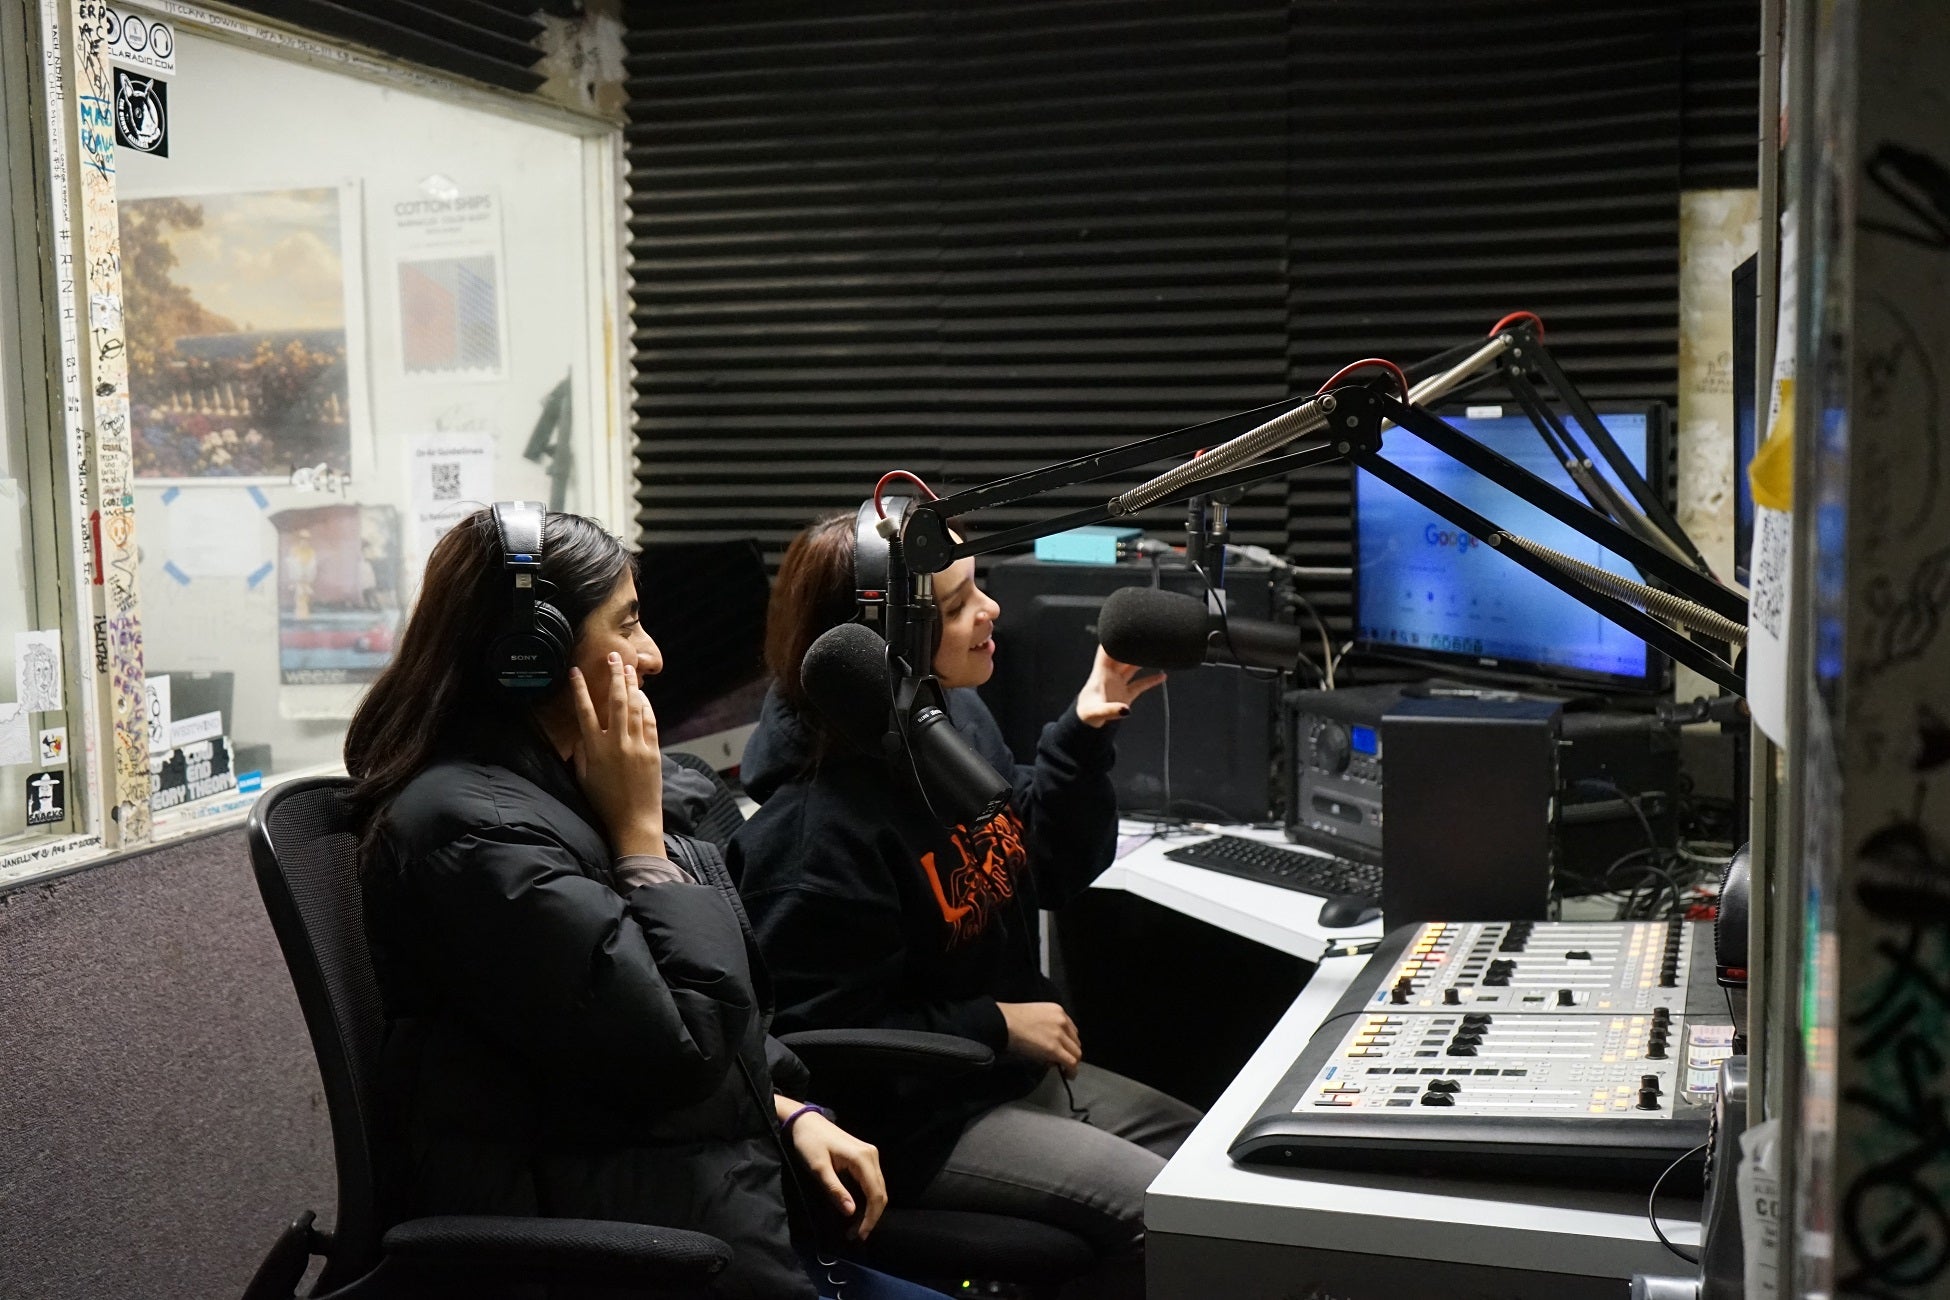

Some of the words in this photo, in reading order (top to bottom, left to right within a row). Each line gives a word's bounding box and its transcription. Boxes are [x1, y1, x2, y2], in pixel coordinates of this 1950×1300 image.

[394, 199, 452, 216] COTTON
[455, 194, 492, 212] SHIPS
[186, 760, 212, 783] END
[28, 809, 63, 824] SNACKS
